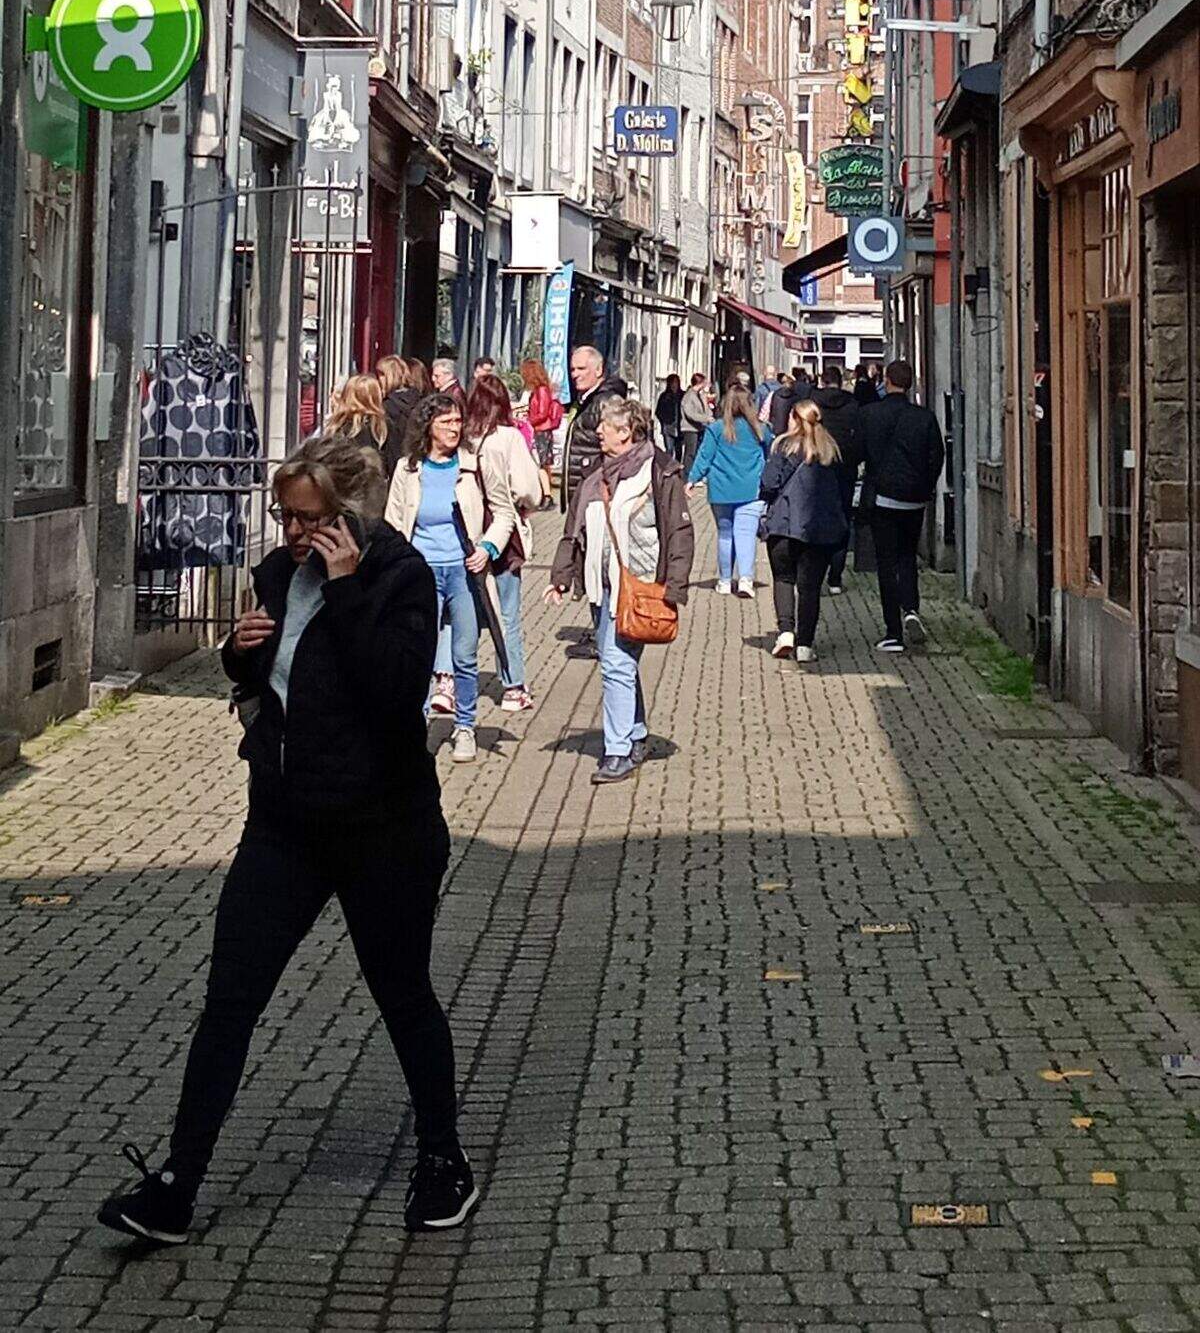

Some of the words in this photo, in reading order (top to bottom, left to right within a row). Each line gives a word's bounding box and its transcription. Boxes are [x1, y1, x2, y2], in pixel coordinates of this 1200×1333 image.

[624, 110, 668, 130] Galerie
[616, 133, 630, 152] D.
[547, 295, 567, 385] SUSHI
